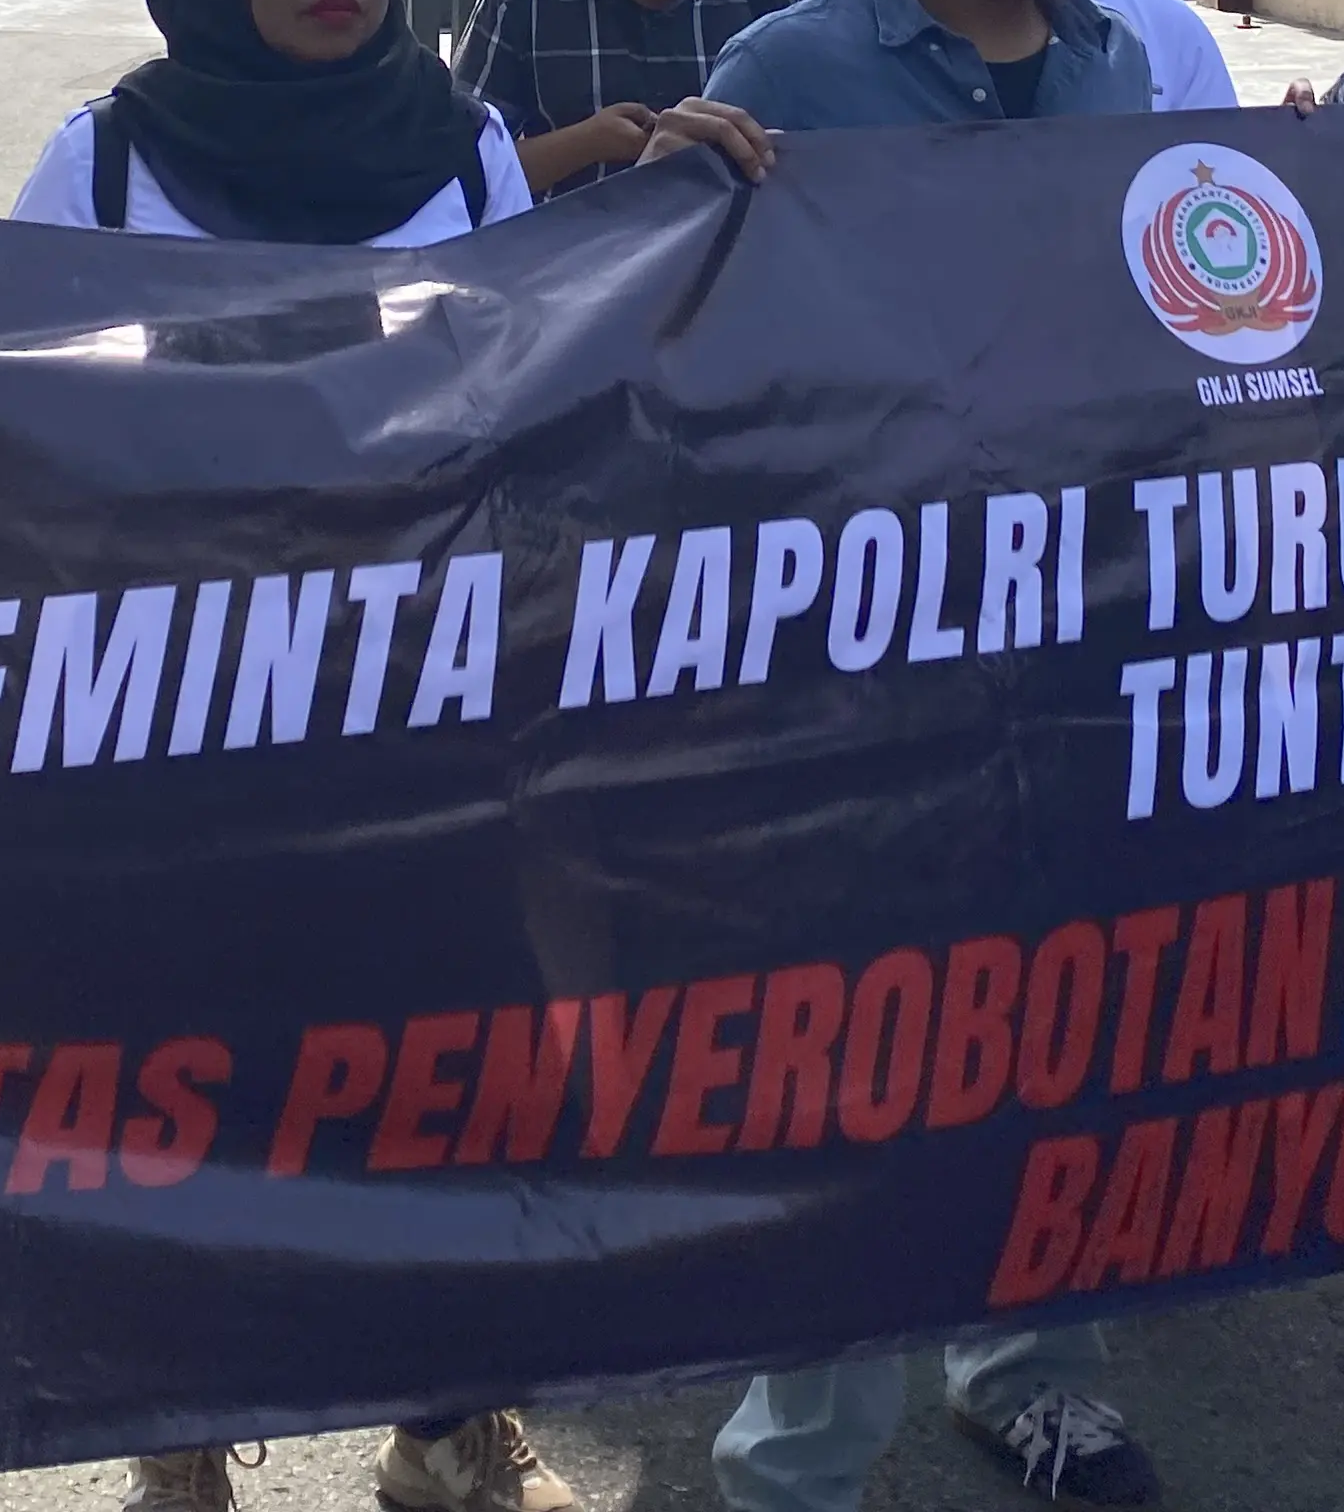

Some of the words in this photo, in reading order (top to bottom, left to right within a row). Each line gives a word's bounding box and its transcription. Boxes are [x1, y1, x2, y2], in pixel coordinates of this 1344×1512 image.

[1196, 375, 1244, 407] GKJI
[1244, 367, 1324, 401] SUMSEL
[558, 485, 1086, 710] KAPOLRI
[266, 878, 1335, 1178] PENYEROBOTAN
